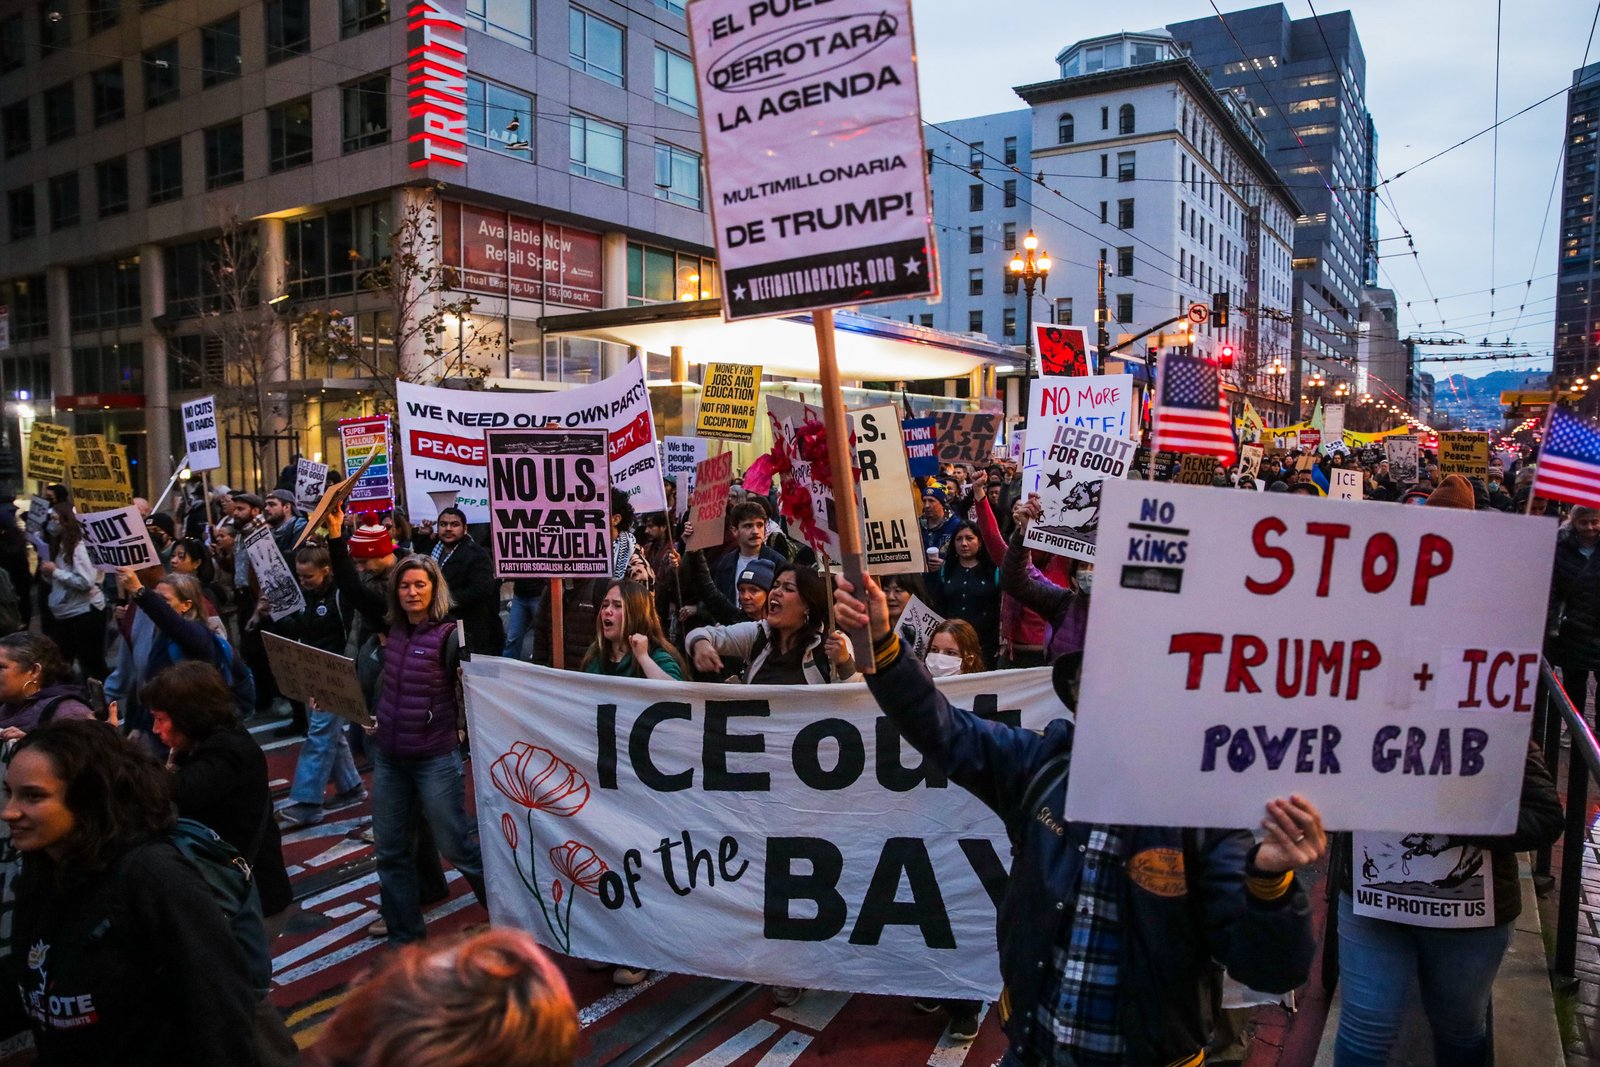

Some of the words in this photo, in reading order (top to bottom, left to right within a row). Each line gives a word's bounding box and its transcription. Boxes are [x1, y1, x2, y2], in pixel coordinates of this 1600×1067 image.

[713, 10, 897, 89] DERROTARÁ
[415, 0, 467, 165] TRINITY
[717, 106, 752, 132] LA
[757, 65, 902, 121] AGENDA
[722, 155, 907, 206] MULTIMILLONARIA
[725, 220, 766, 248] DE
[771, 192, 914, 239] TRUMP!
[543, 234, 572, 253] Now
[485, 244, 524, 265] Retail
[527, 252, 566, 272] Space
[1249, 229, 1258, 282] HOTEL
[748, 256, 896, 301] WEFIGHTBACK2025.ORG
[524, 284, 535, 295] Up
[714, 364, 740, 375] MONEY
[740, 366, 754, 376] FOR
[711, 374, 733, 386] JOBS
[734, 376, 754, 388] AND
[705, 386, 755, 401] EDUCATION
[1040, 386, 1071, 417] NO
[1077, 385, 1120, 409] MORE
[184, 405, 194, 419] NO
[194, 401, 213, 416] CUTS
[406, 401, 443, 420] WE
[447, 409, 510, 427] NEED
[513, 413, 561, 428] OUR
[565, 404, 609, 428] OWN
[701, 402, 715, 412] NOT
[716, 403, 731, 414] FOR
[731, 405, 749, 416] WAR
[749, 406, 755, 416] &
[186, 421, 195, 433] NO
[195, 416, 214, 431] RAIDS
[345, 426, 366, 436] SUPER
[703, 416, 749, 430] OCCUPATION
[346, 436, 375, 446] CALLOUS
[910, 427, 931, 441] NOW
[936, 430, 994, 447] AST
[1053, 425, 1089, 449] ICE
[1088, 433, 1132, 460] OUT
[1440, 433, 1456, 441] The
[1457, 433, 1485, 444] People
[189, 441, 197, 453] NO
[197, 437, 217, 452] WARS
[348, 447, 372, 456] FASCIST
[418, 437, 485, 460] PEACE
[668, 442, 680, 452] We
[682, 442, 695, 452] the
[907, 443, 935, 459] TRUMP
[1451, 443, 1474, 452] Want
[668, 454, 694, 465] people
[1047, 443, 1080, 466] FOR
[1080, 451, 1125, 478] GOOD
[1444, 452, 1471, 460] Peace
[298, 467, 309, 477] FOR
[309, 471, 325, 481] GOOD
[310, 463, 327, 473] OUT
[415, 469, 473, 488] HUMAN
[628, 456, 656, 477] GREED
[697, 450, 733, 483] ARREST
[1440, 463, 1456, 473] Not
[1457, 464, 1474, 473] War
[1475, 466, 1486, 474] on
[492, 457, 538, 502] NO
[543, 458, 605, 502] U.S.
[1182, 471, 1212, 485] GOOD
[1337, 472, 1356, 486] ICE
[352, 490, 372, 498] POTUS
[494, 509, 606, 530] WAR
[698, 499, 724, 521] ROSS
[1139, 498, 1176, 524] NO
[90, 513, 132, 543] OUT
[541, 526, 561, 534] ON
[496, 531, 607, 559] VENEZUELA
[1027, 530, 1044, 543] WE
[1044, 535, 1087, 553] PROTECT
[97, 543, 151, 567] GOOD!
[881, 553, 909, 562] Liberation
[1244, 515, 1454, 606] STOP
[501, 562, 520, 572] PARTY
[520, 562, 532, 572] FOR
[533, 562, 563, 572] SOCIALISM
[563, 562, 572, 572] &
[572, 562, 606, 572] LIBERATION
[1167, 632, 1382, 701] TRUMP
[1456, 648, 1539, 714] ICE
[597, 699, 772, 793] ICE
[1200, 724, 1342, 776] POWER
[1371, 725, 1489, 777] GRAB
[1036, 806, 1065, 837] Steve
[598, 849, 642, 911] of
[653, 829, 750, 897] the
[1356, 889, 1382, 908] WE
[1386, 895, 1462, 917] PROTECT
[1464, 902, 1486, 917] US
